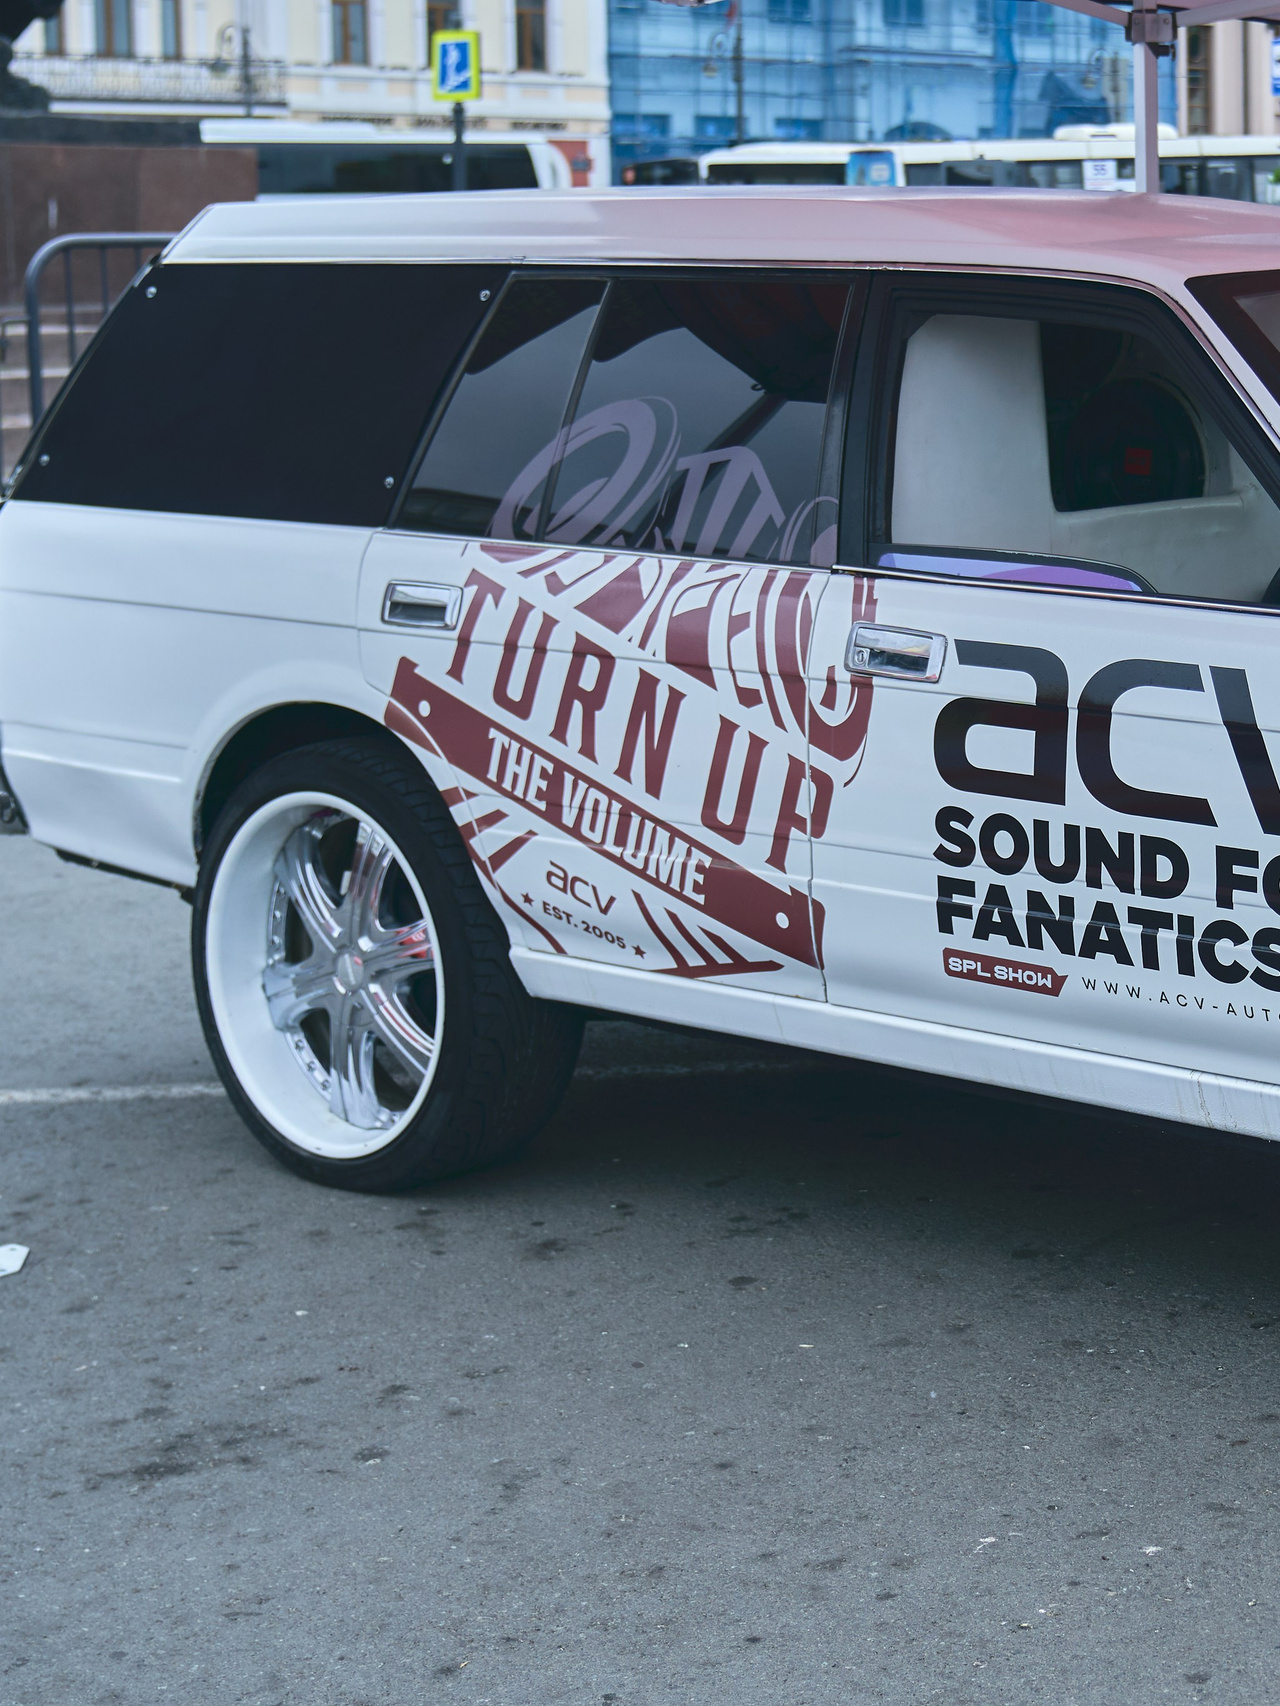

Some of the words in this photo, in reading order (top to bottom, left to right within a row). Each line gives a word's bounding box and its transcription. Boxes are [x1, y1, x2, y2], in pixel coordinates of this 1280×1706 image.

[446, 568, 688, 801] TURN
[700, 713, 835, 875] UP
[486, 727, 555, 812] THE
[561, 770, 713, 906] VOLUME
[932, 804, 1191, 900] SOUND
[541, 900, 579, 928] EST.
[580, 919, 627, 950] 2005
[545, 859, 617, 916] acv
[947, 956, 992, 979] SPL
[992, 964, 1053, 989] SHOW
